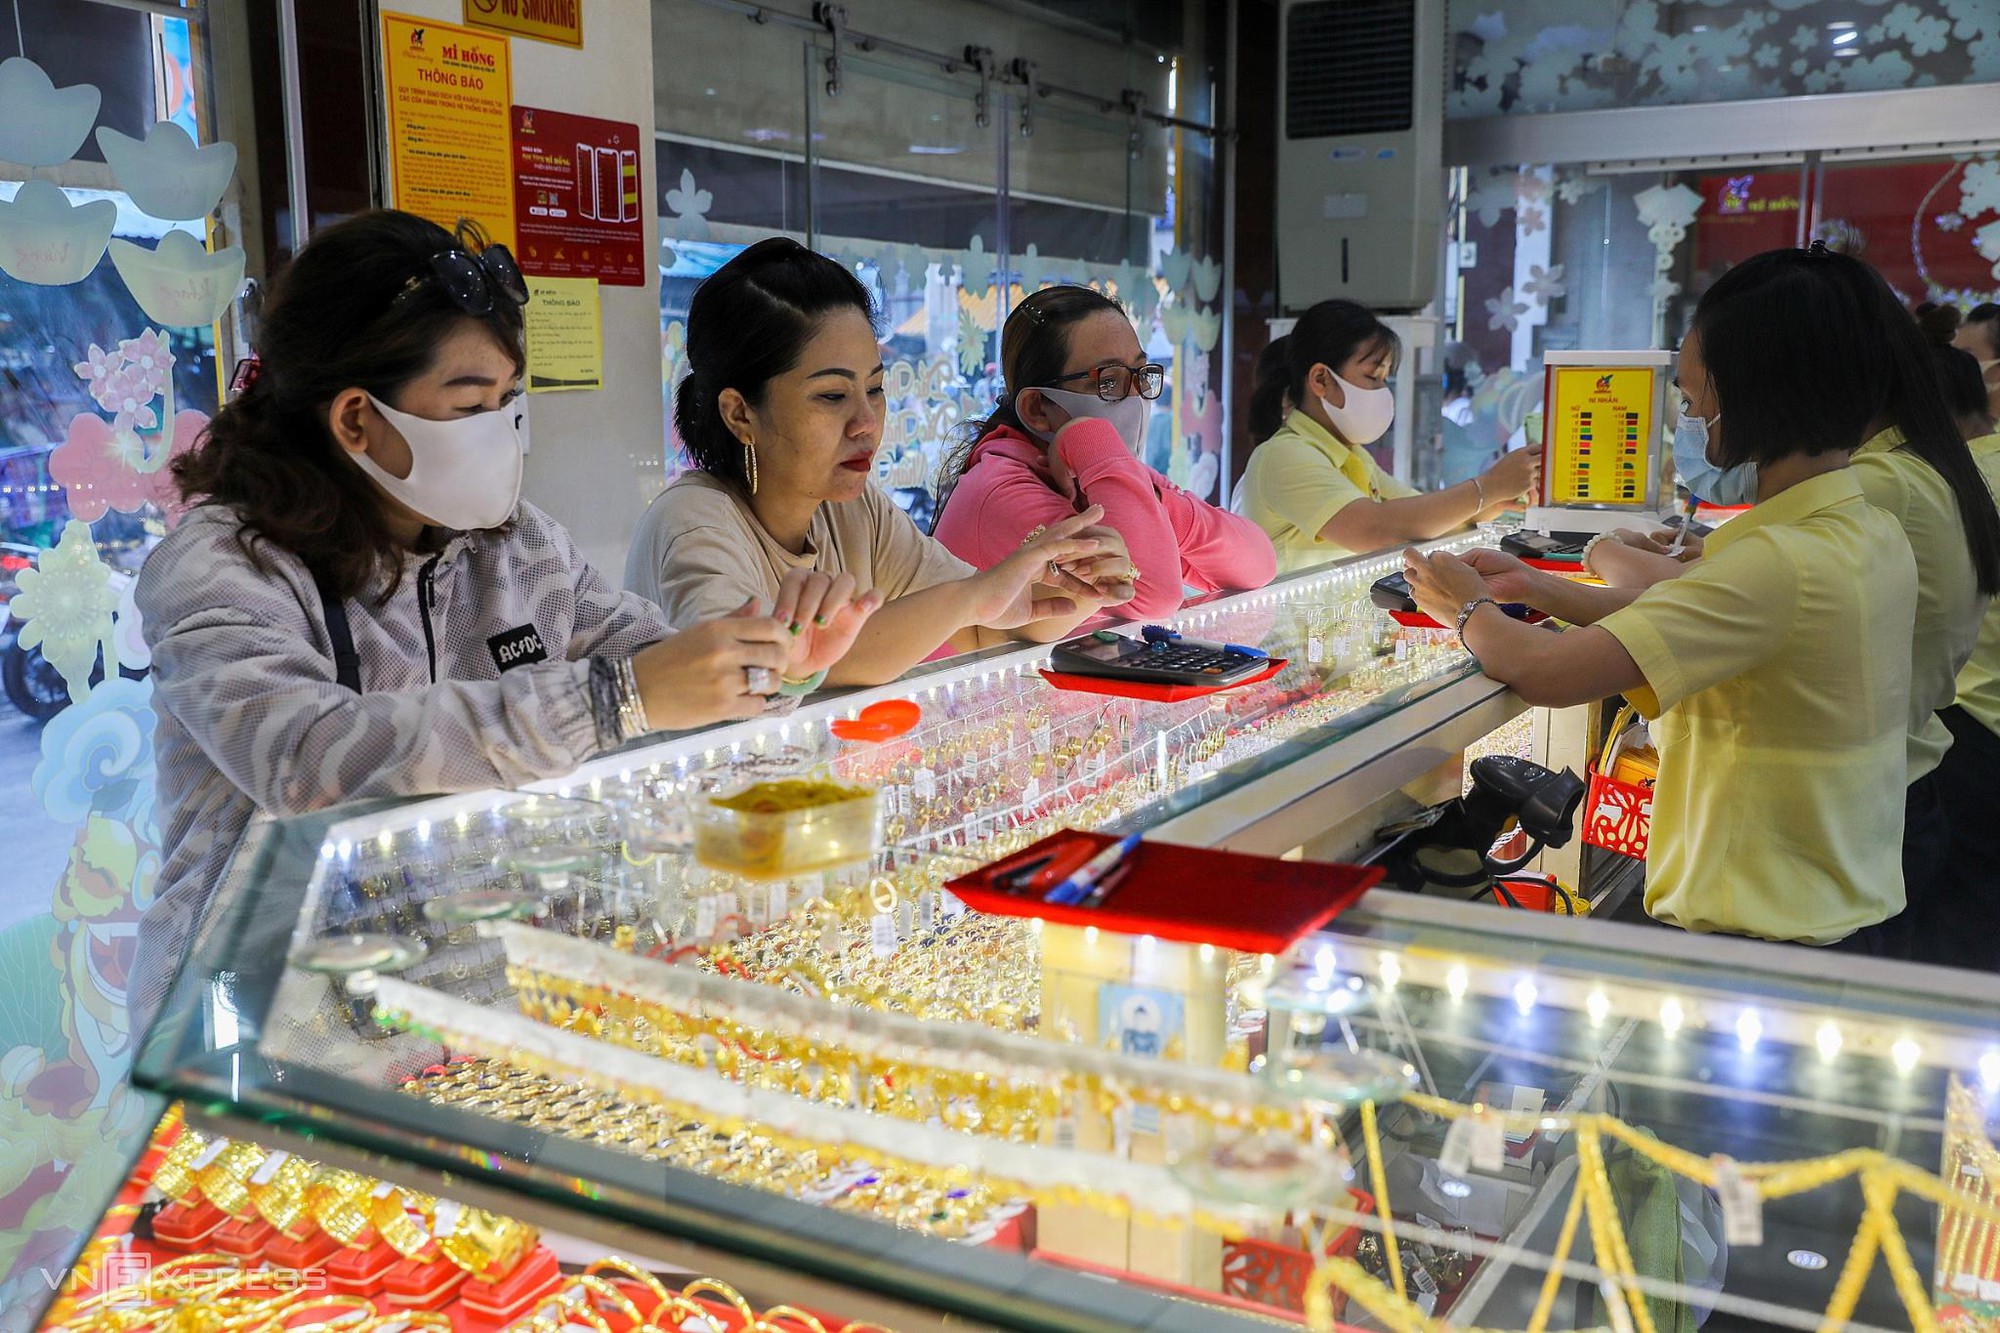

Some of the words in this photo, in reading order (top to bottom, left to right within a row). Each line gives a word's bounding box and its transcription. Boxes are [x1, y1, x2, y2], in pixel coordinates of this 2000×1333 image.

[522, 0, 575, 29] SMOKING
[417, 68, 457, 86] THÔNG
[461, 74, 484, 90] BÁO
